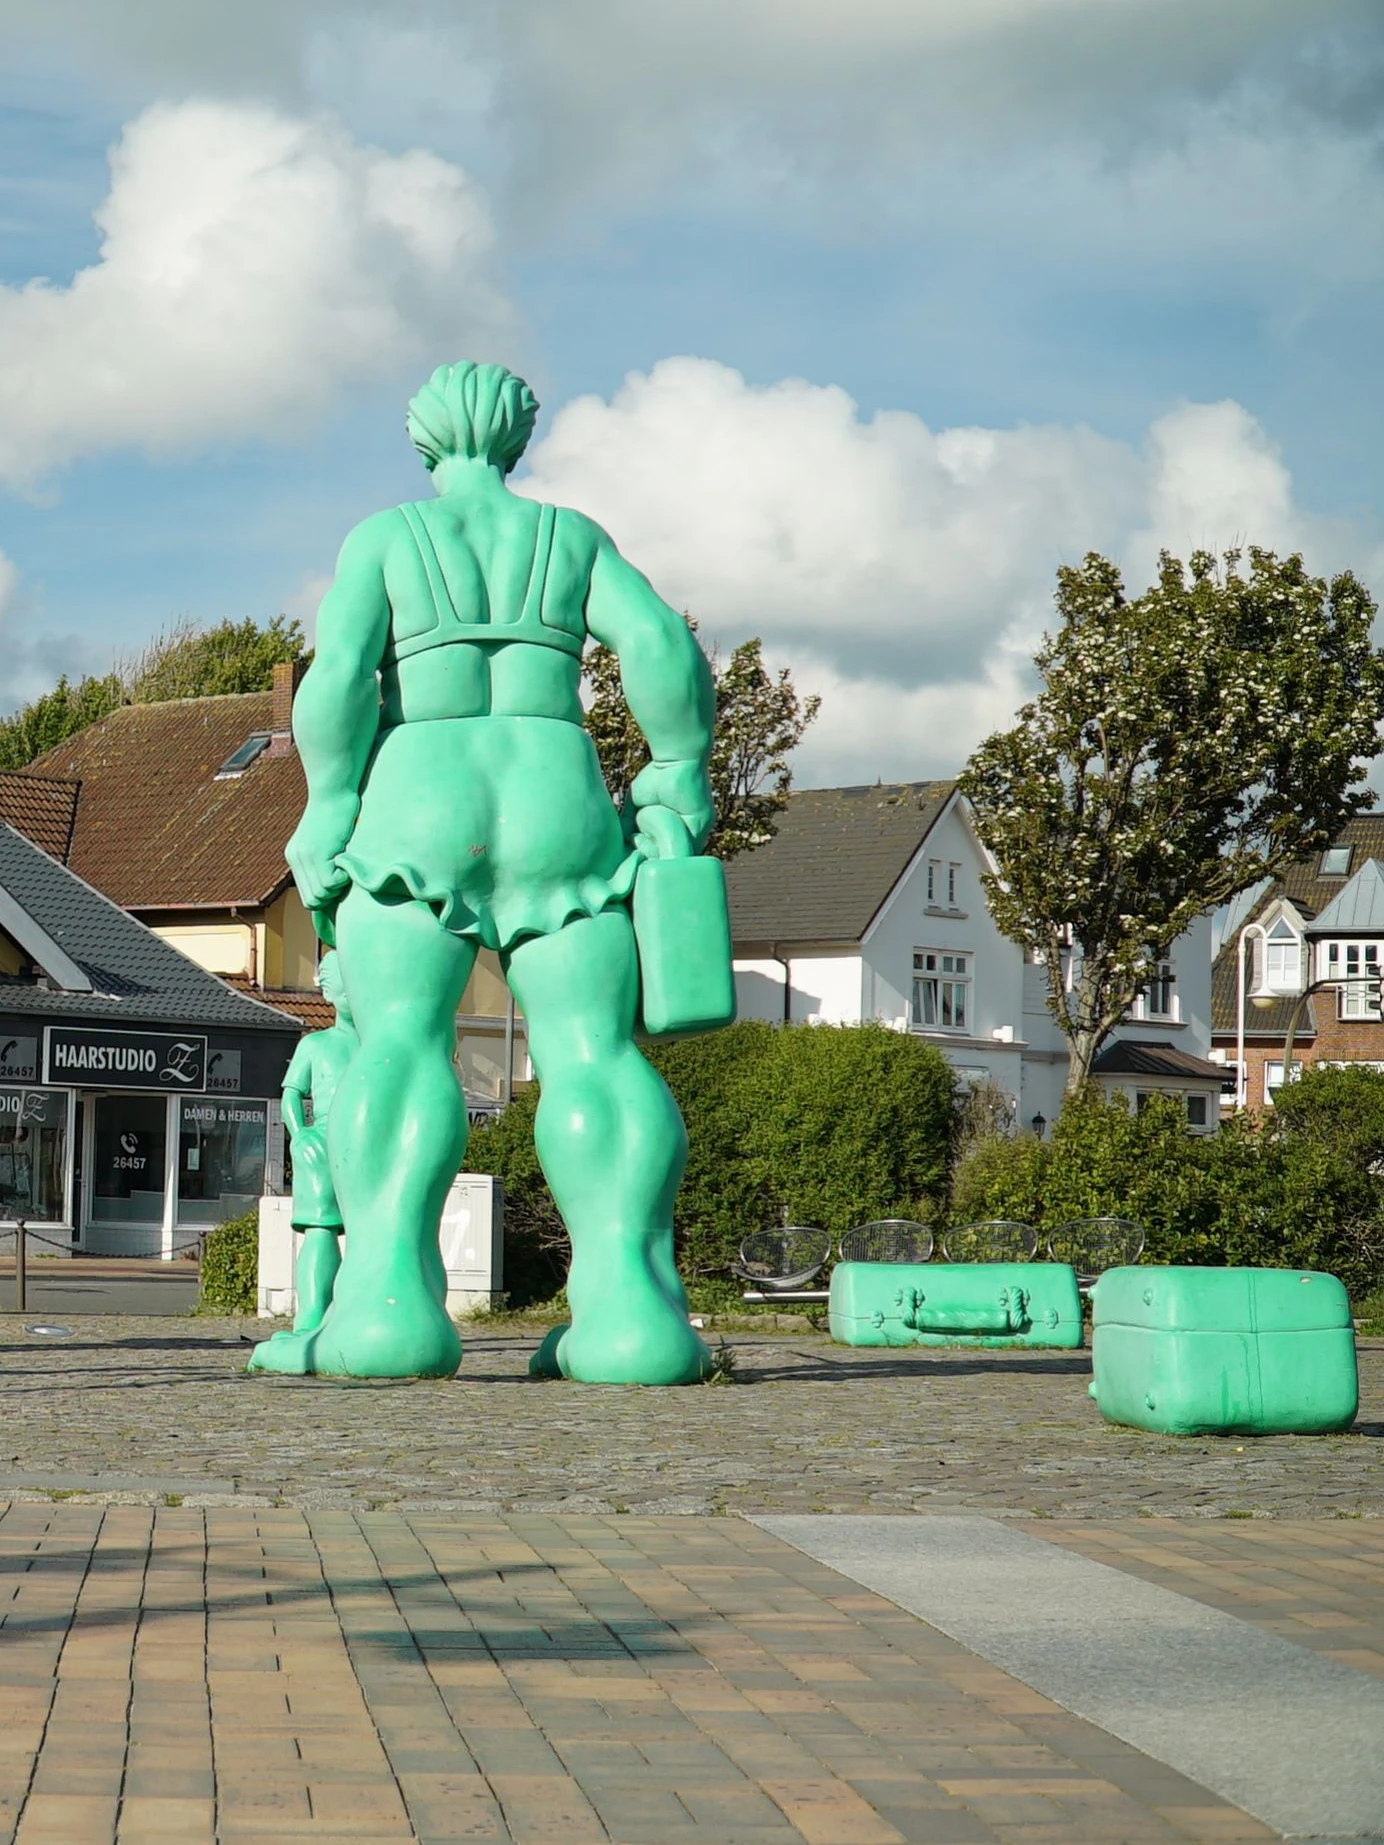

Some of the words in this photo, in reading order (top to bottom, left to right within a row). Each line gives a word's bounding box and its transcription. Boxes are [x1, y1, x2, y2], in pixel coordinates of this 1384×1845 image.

[55, 1044, 157, 1072] HAARSTUDIO
[0, 1066, 34, 1077] 26457
[207, 1078, 239, 1089] 26457
[184, 1107, 217, 1120] DAMEN
[218, 1109, 226, 1121] &
[228, 1109, 264, 1122] HERREN
[113, 1156, 146, 1169] 26457
